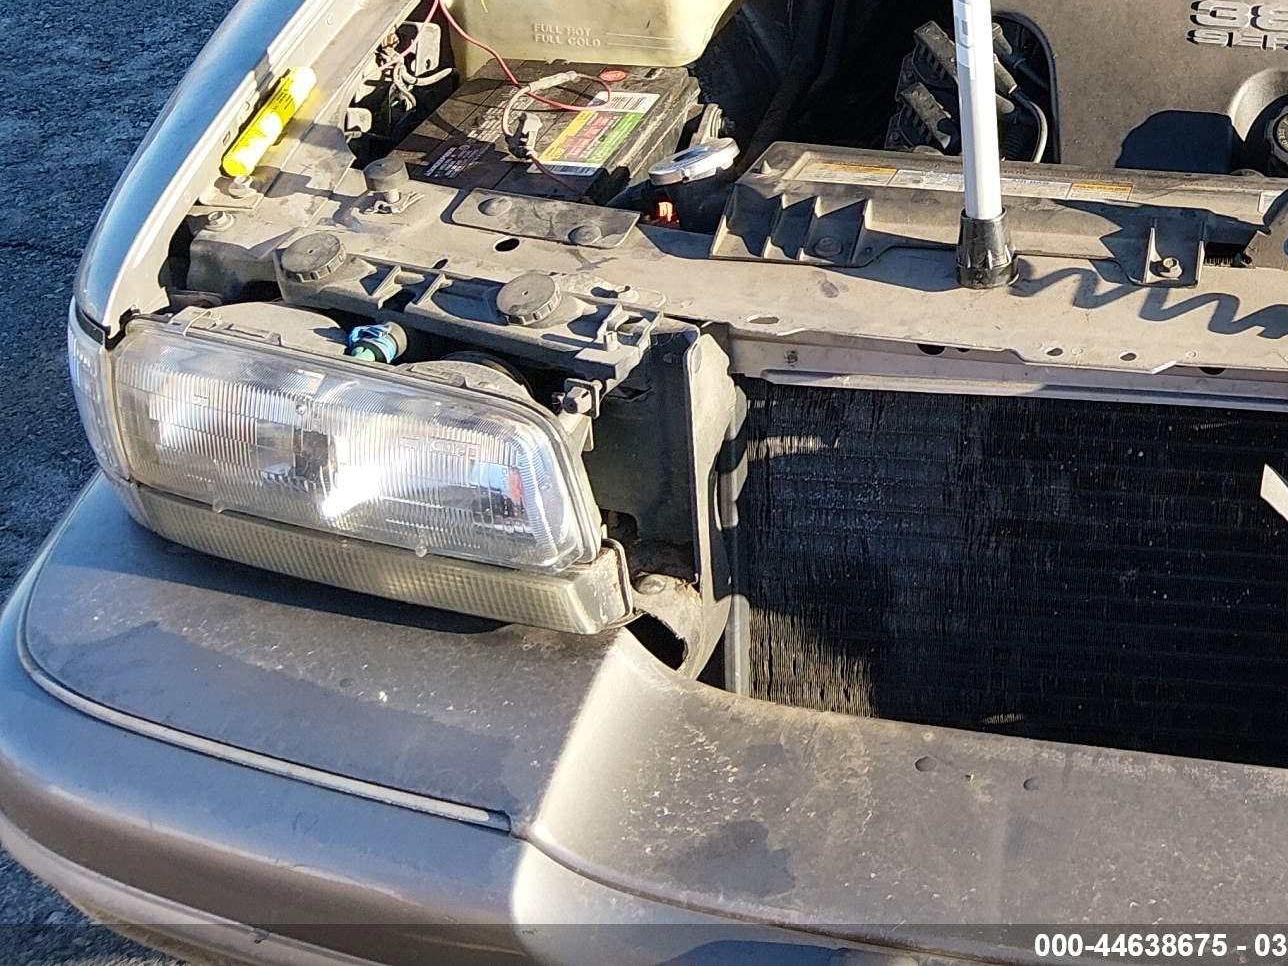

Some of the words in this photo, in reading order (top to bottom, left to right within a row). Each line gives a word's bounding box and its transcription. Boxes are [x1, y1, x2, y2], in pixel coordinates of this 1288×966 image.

[533, 23, 563, 35] FULL
[566, 26, 592, 37] HOT
[534, 33, 564, 44] FULL
